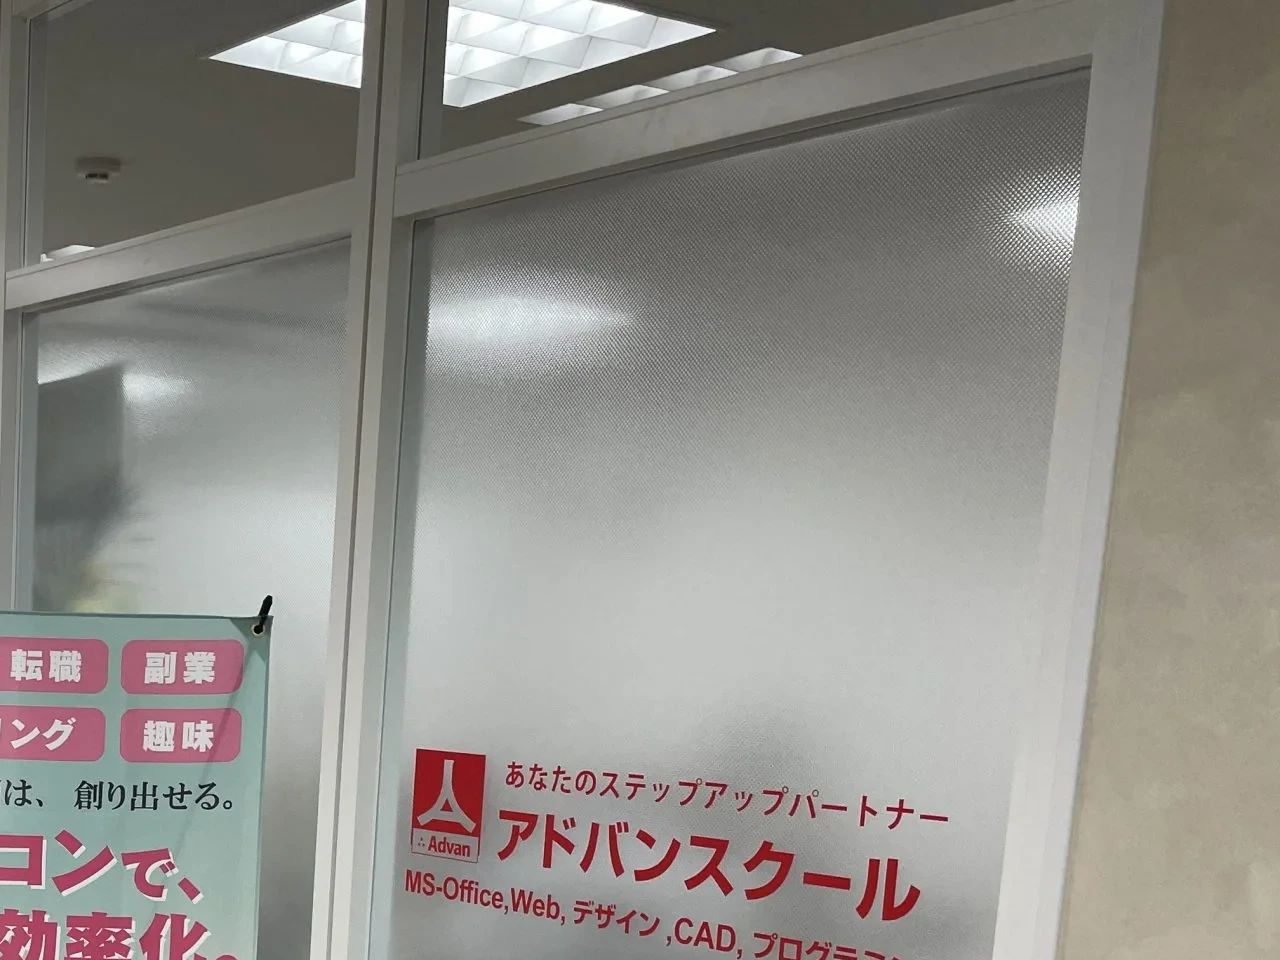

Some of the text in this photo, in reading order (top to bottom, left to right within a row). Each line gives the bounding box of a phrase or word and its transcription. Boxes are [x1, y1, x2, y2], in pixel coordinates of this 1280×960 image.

[10, 648, 82, 682] 転職
[144, 651, 216, 684] 副業
[143, 720, 215, 753] 趣味
[505, 761, 949, 829] あなたのステップアップパートナー
[428, 836, 470, 857] Advan
[497, 810, 921, 920] アドバンスクール
[573, 900, 661, 936] デザイン
